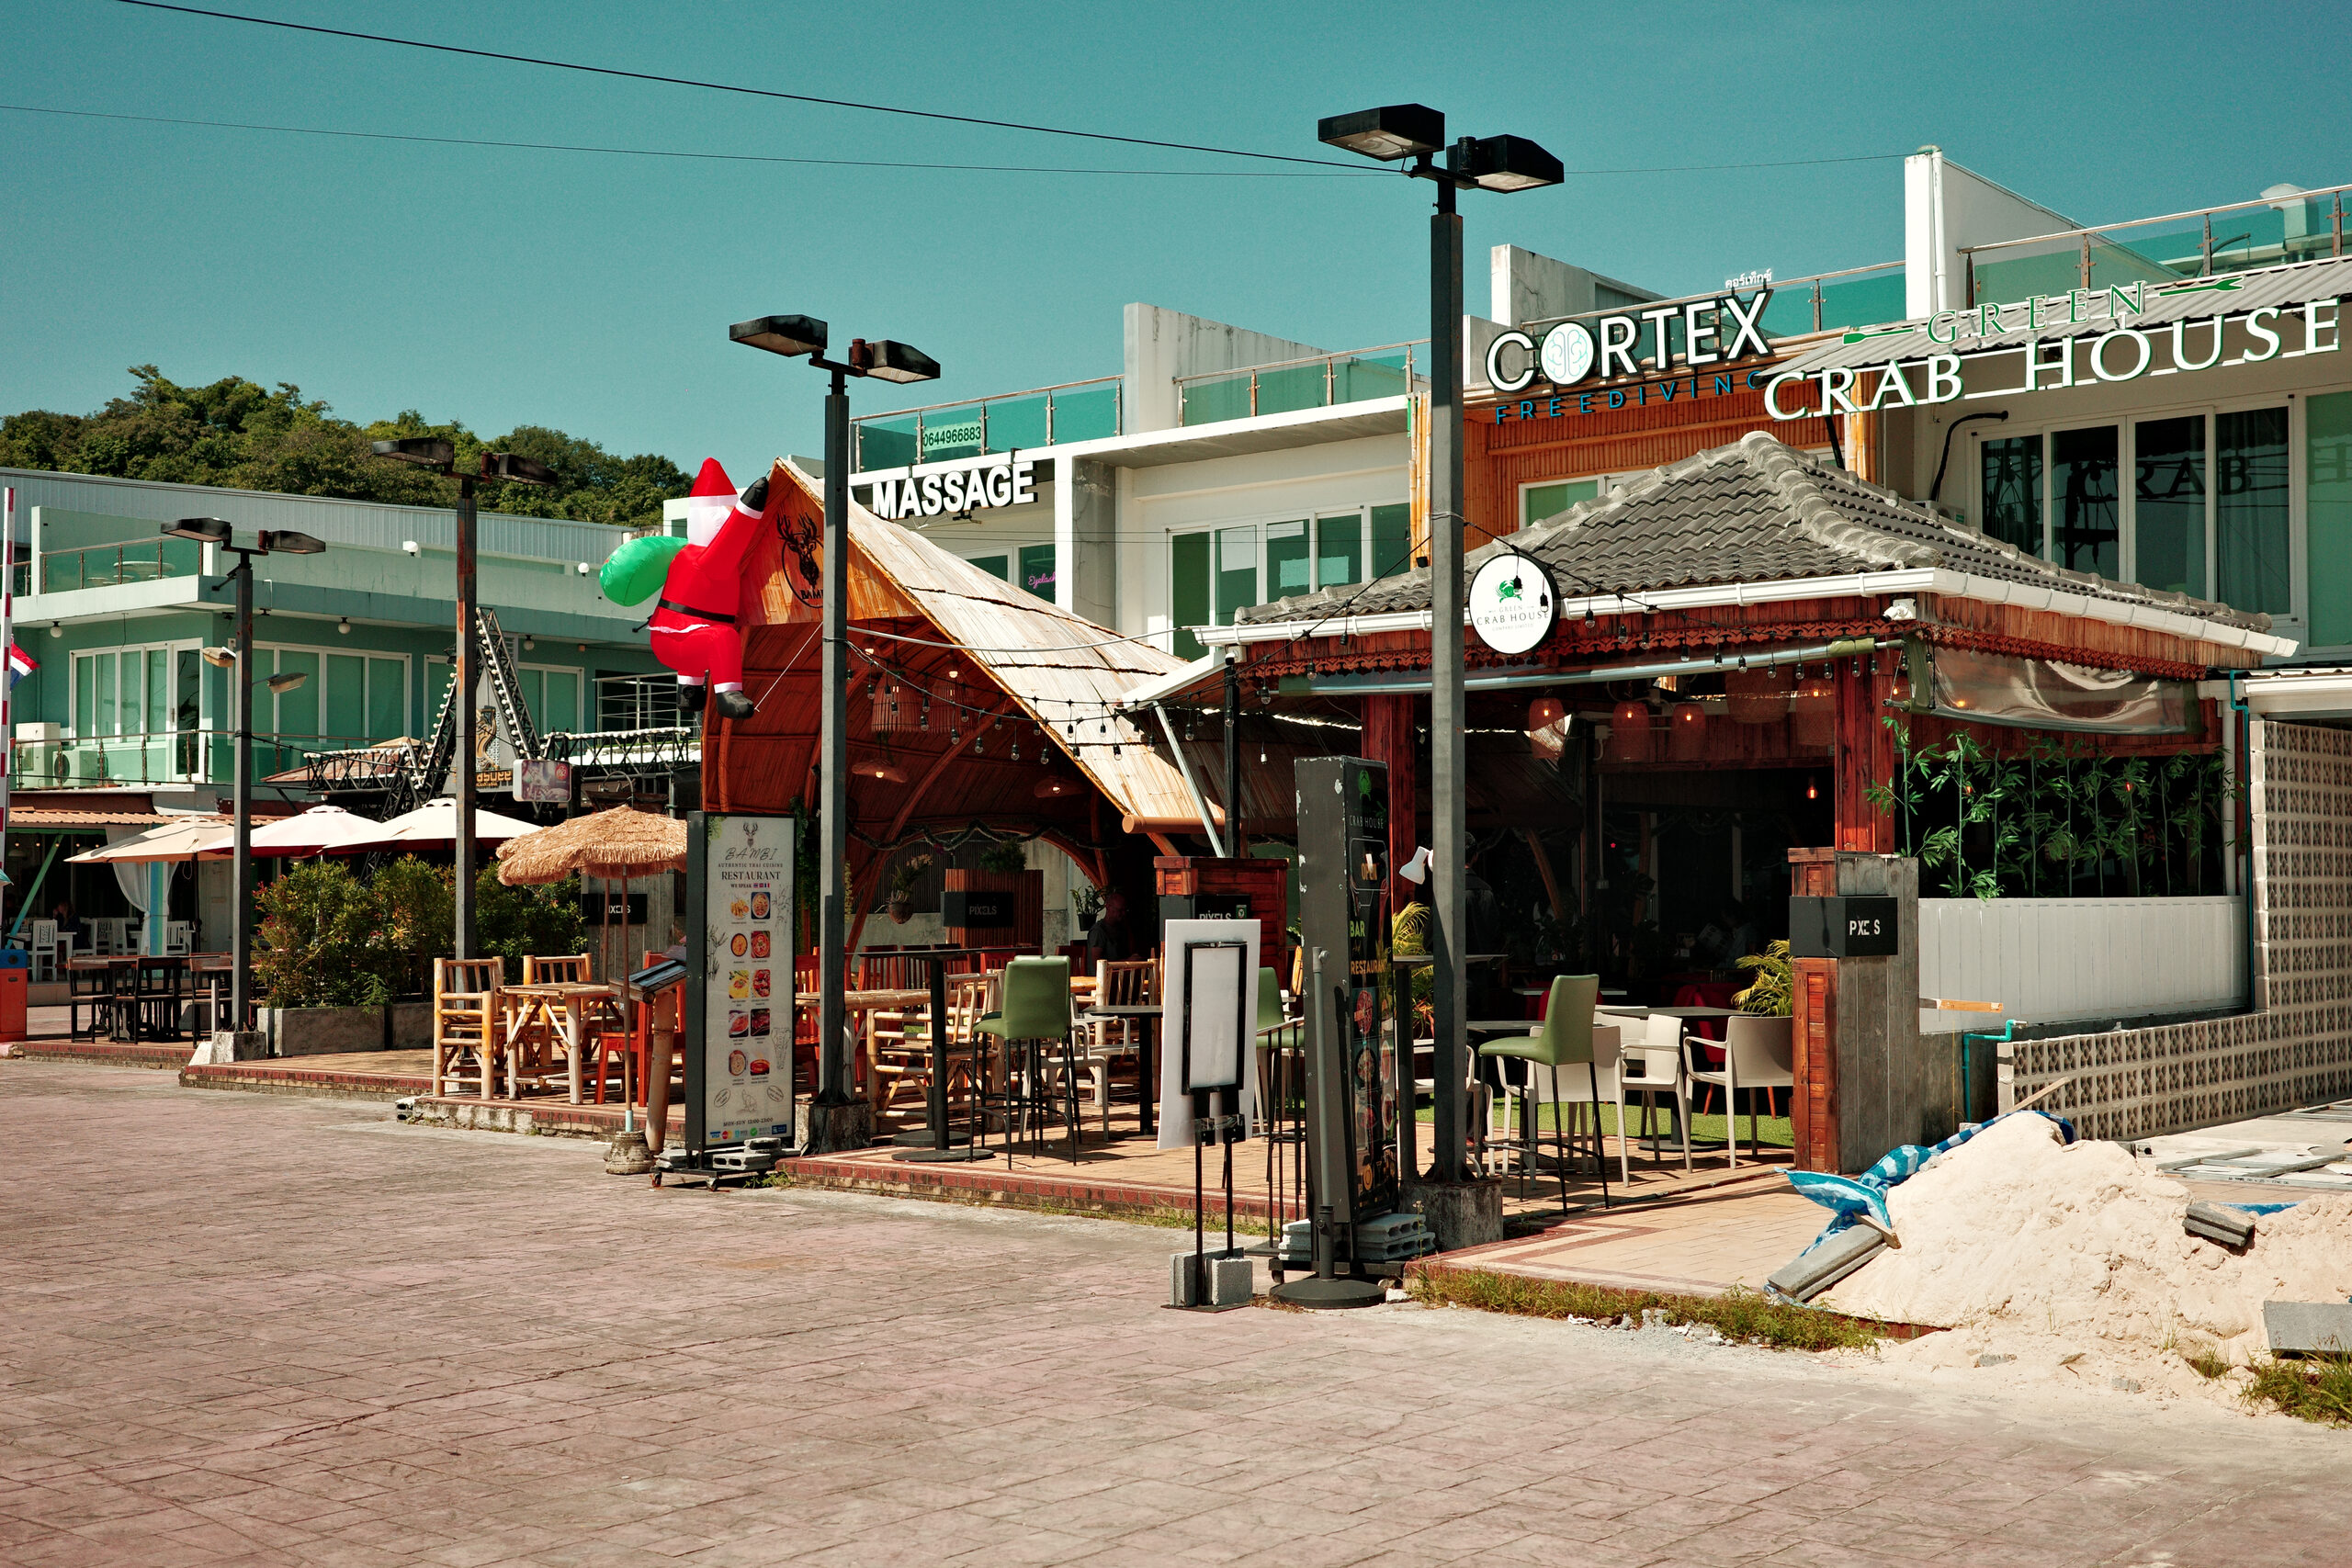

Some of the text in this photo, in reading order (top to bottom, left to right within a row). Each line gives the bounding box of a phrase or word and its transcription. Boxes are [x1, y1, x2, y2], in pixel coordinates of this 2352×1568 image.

[1927, 280, 2147, 344] GREEN
[1486, 289, 1772, 392] CORTEX
[1764, 298, 2341, 421] CRAB HOUSE
[923, 426, 981, 446] 0644966883
[873, 460, 1037, 520] MASSAGE
[800, 589, 823, 600] BAM
[1476, 611, 1549, 626] CRAB HOUSE
[1350, 816, 1384, 829] CRAB HOUSE
[725, 847, 778, 861] BAMBI
[721, 871, 781, 880] RESTAURANT
[969, 905, 998, 916] PIXELS
[1350, 920, 1365, 937] BAR
